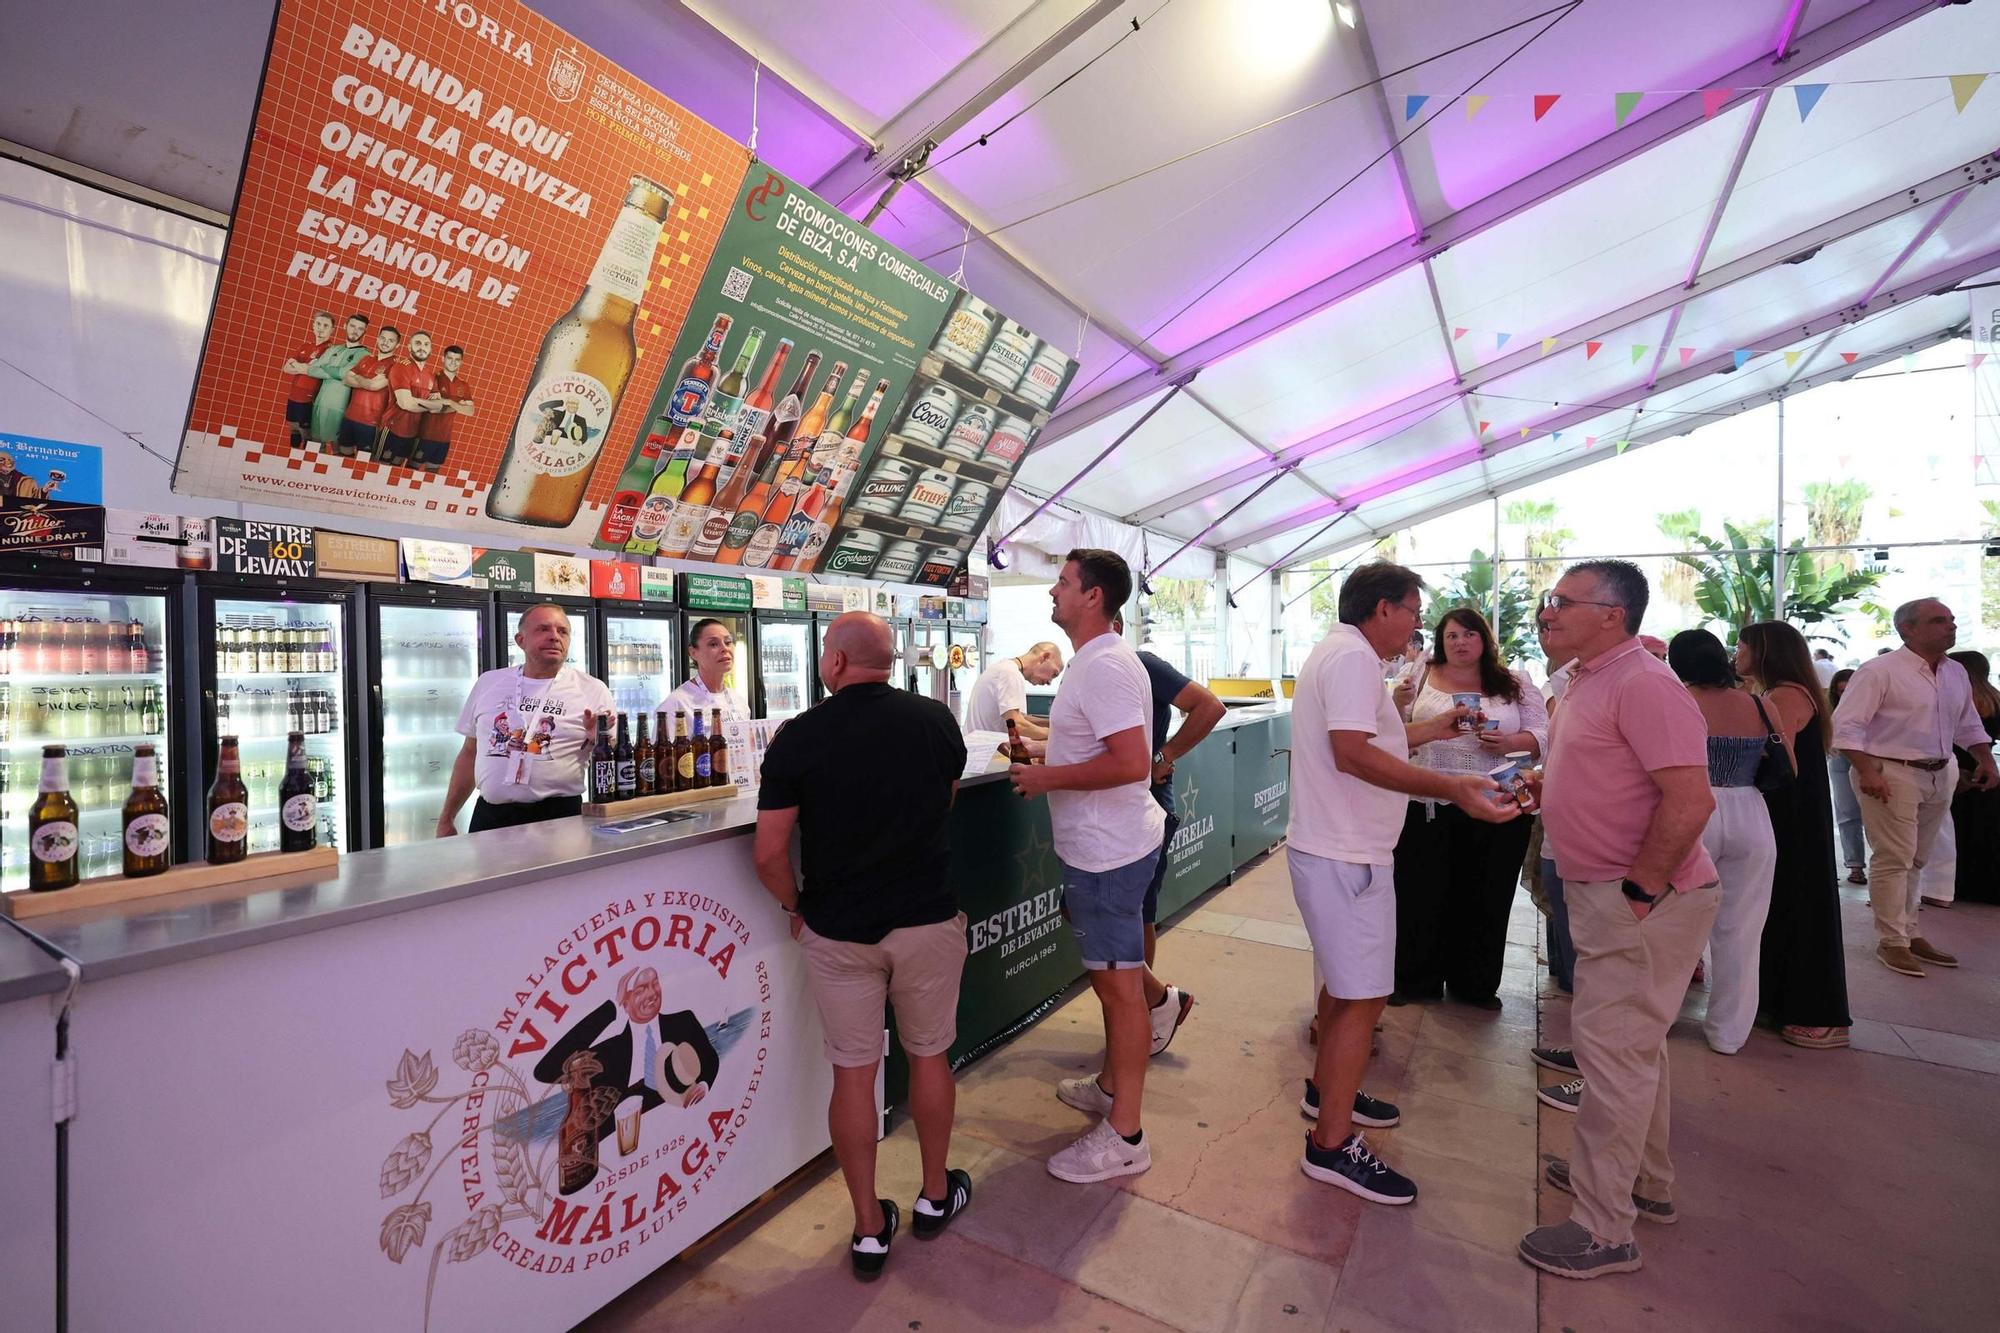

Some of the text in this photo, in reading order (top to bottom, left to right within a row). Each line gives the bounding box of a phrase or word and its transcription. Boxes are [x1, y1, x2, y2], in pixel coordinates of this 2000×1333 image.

[421, 0, 533, 67] TORIA
[341, 23, 572, 160] BRINDA AQUÍ
[597, 74, 680, 130] CERVEZA OFICIAL
[593, 85, 676, 140] DE LA SELECCIÓN
[586, 108, 672, 161] POR PRIMERA VEZ
[589, 97, 691, 161] ESPAÑOLA DE FÚTBOL
[332, 75, 592, 218] CON LA CERVEZA
[320, 122, 505, 220] OFICIAL DE
[307, 164, 530, 272] LA SELECCIÓN
[776, 212, 858, 273] DE IBIZA, S.A.
[784, 193, 948, 302] PROMOCIONES COMERCIALES
[297, 208, 520, 308] ESPAÑOLA DE
[778, 245, 818, 273] Distribución
[286, 251, 420, 315] FÚTBOL
[602, 265, 638, 287] VICTORIA
[742, 256, 763, 275] Vinos,
[764, 270, 786, 287] cavas,
[787, 281, 804, 294] agua
[804, 289, 828, 307] mineral,
[828, 302, 848, 316] zumos
[780, 261, 806, 281] Cerveza
[806, 276, 815, 286] en
[991, 342, 1027, 368] ESTRELLA
[1031, 365, 1058, 387] VICTORIA
[536, 382, 604, 417] VICTORIA
[681, 391, 700, 413] T
[912, 401, 950, 430] Coors
[734, 411, 758, 454] PUNK IPA
[954, 425, 984, 444] PERONI
[16, 441, 80, 458] Bernardus
[525, 442, 585, 467] MÁLAGA
[242, 473, 417, 506] www.cervezavictoria.es
[865, 483, 906, 494] CARLING
[912, 485, 948, 506] TETLEY'S
[4, 515, 65, 537] Miller
[140, 521, 169, 531] Asahi
[612, 513, 634, 521] SAGRA
[640, 511, 669, 522] PERONI
[707, 521, 728, 529] ESTRELLA
[46, 531, 88, 542] DRAFT
[180, 529, 210, 542] Asahi
[220, 536, 247, 555] DE
[245, 521, 312, 545] ESTRE
[328, 538, 385, 552] ESTRELLA
[273, 542, 302, 560] 60
[342, 551, 383, 561] LEVANTE
[488, 565, 517, 581] JEVER
[880, 559, 916, 572] THATCHERS
[38, 701, 103, 711] MILLER
[519, 703, 562, 715] cereza
[521, 695, 564, 707] feria la
[1254, 780, 1287, 809] ESTRELLA
[1167, 814, 1214, 855] STRELLA
[1173, 840, 1204, 864] DE LEVANTE
[1175, 865, 1192, 879] MURCIA
[970, 883, 1064, 954] ESTREL
[1001, 915, 1062, 958] DE LEVANTE
[495, 891, 751, 1034] MALAGUEÑA Y EXQUISITA
[1005, 943, 1057, 979] MURCIA 1963
[507, 914, 736, 1059] VICTORIA
[492, 960, 772, 1274] CREADA POR LUIS FRANQUELO EN 1928
[461, 1071, 489, 1211] CERVEZA
[535, 1106, 735, 1245] MÁLAGA
[595, 1134, 686, 1194] DESDE 1928
